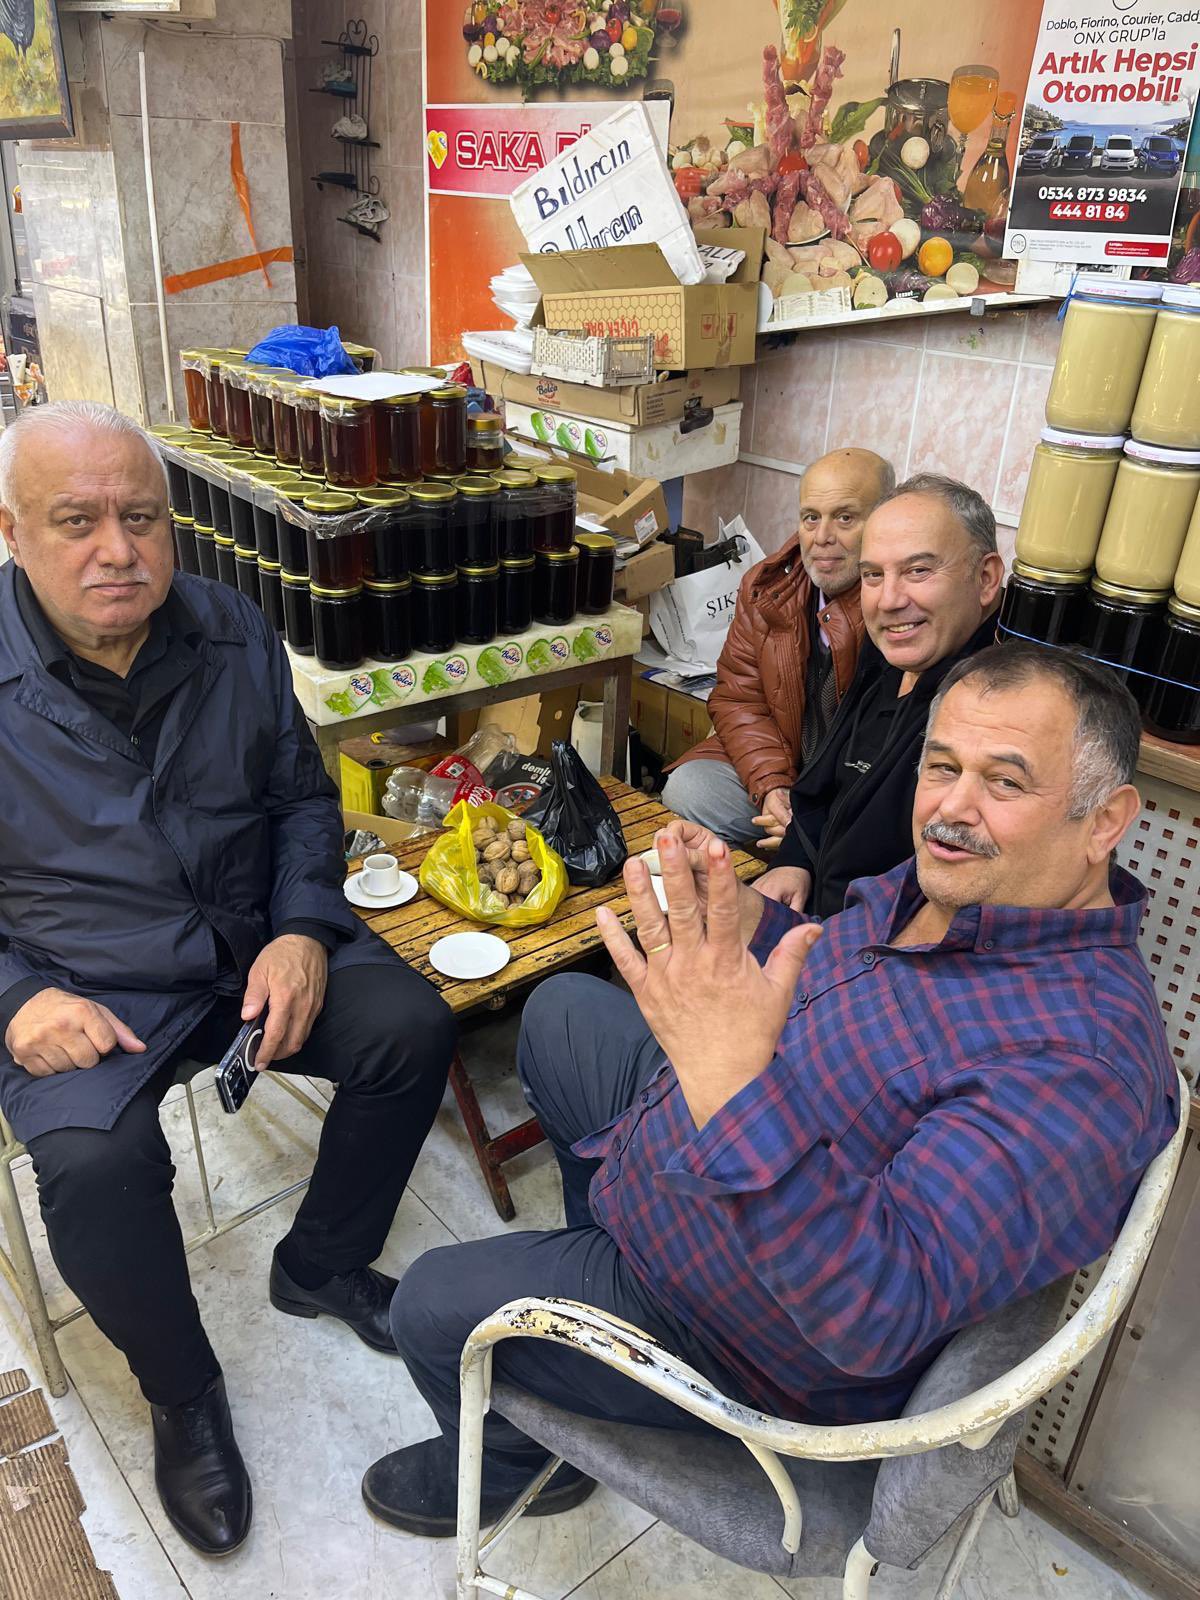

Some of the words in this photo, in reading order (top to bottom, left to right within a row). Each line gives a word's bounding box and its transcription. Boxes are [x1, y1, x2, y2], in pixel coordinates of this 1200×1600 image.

[1046, 18, 1078, 31] Doblo,
[1080, 17, 1119, 29] Fiorino,
[1121, 12, 1164, 26] Courier,
[1167, 10, 1200, 24] Cadd
[1073, 31, 1106, 45] ONX
[1108, 27, 1166, 43] GRUP'la
[1038, 48, 1108, 75] Artık
[1113, 42, 1199, 78] Hepsi
[1042, 75, 1182, 103] Otomobil!
[456, 131, 548, 172] SAKA
[1038, 186, 1074, 200] 0534
[1076, 187, 1105, 201] 873
[1107, 188, 1148, 202] 9834
[1052, 204, 1082, 217] 444
[1085, 205, 1101, 218] 81
[1104, 205, 1125, 219] 84
[594, 629, 612, 645] Bolca
[501, 648, 520, 663] Bolca
[550, 644, 567, 658] Bolca
[445, 664, 466, 676] Bolca
[350, 678, 371, 695] Bolca
[392, 672, 413, 687] Bolca
